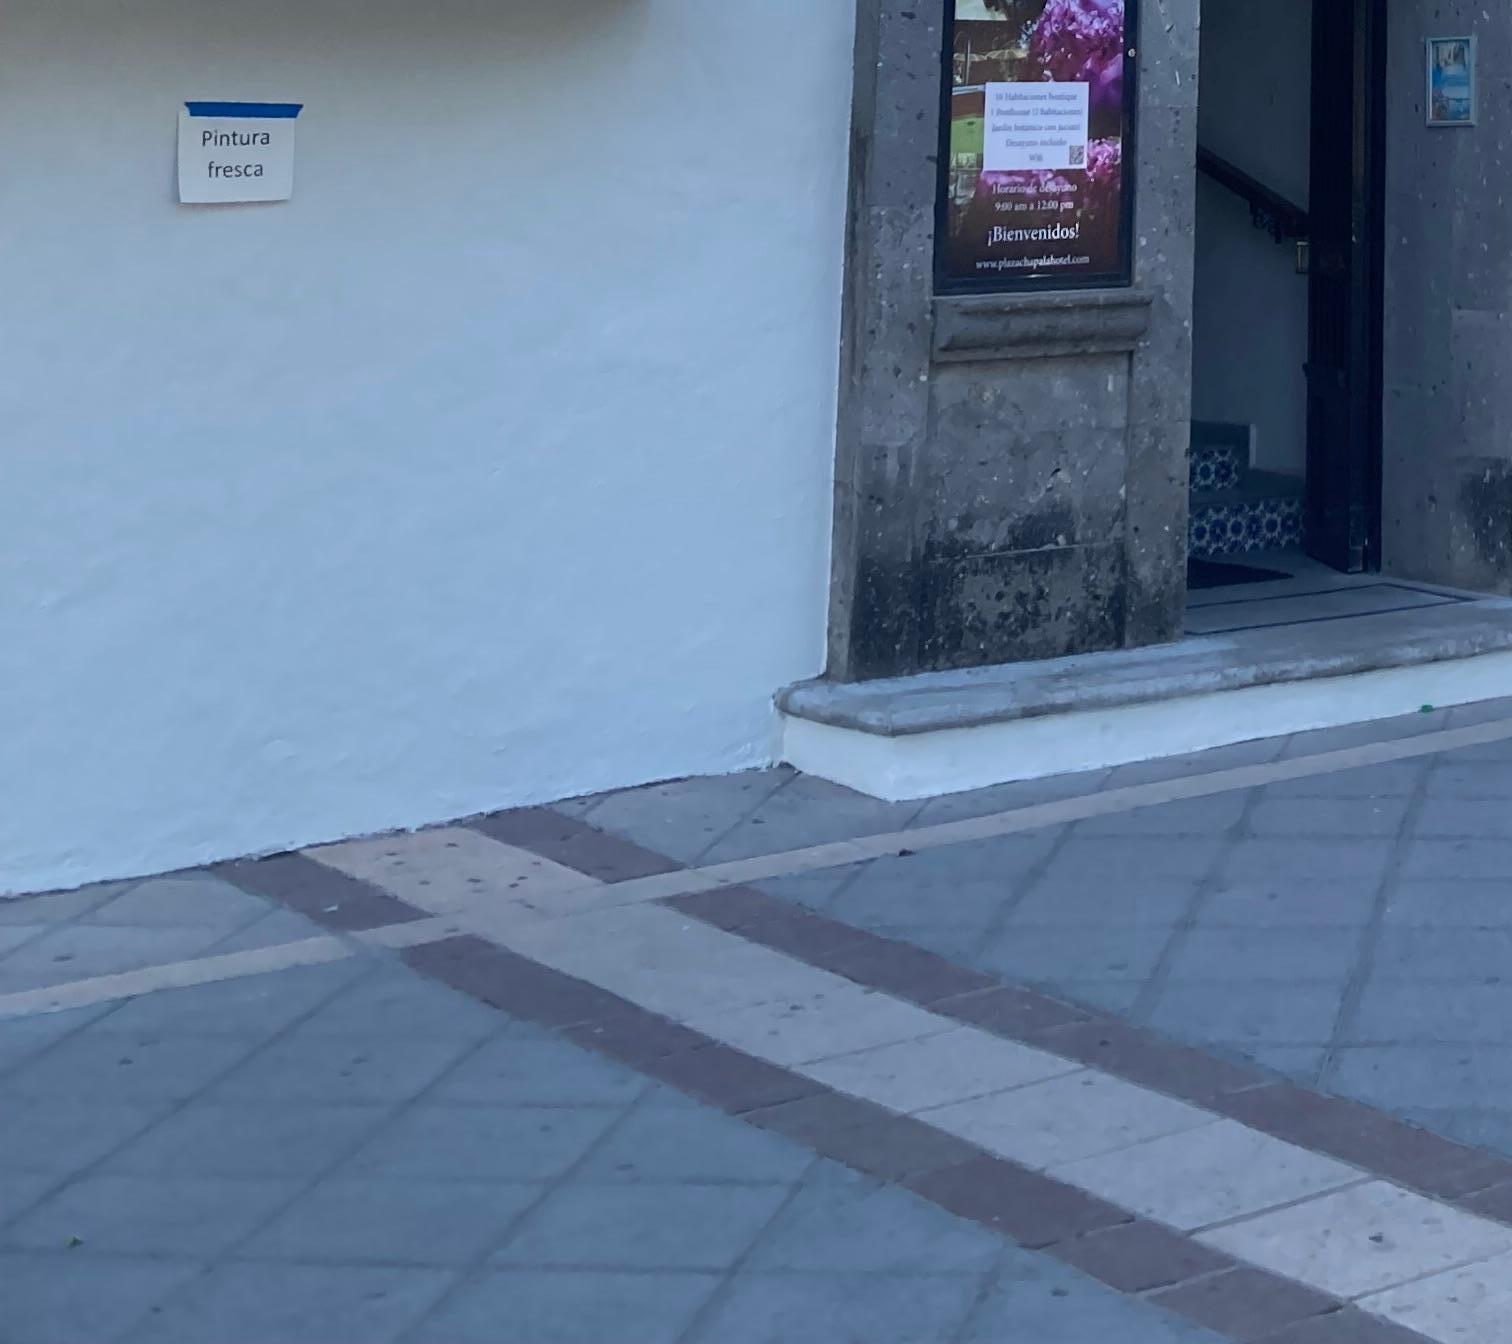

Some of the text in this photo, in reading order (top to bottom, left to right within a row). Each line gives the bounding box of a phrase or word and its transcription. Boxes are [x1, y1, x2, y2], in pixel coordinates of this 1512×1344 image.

[202, 129, 270, 147] Pintura
[208, 161, 263, 178] fresca
[987, 222, 1080, 247] ¡Bienvenidos!
